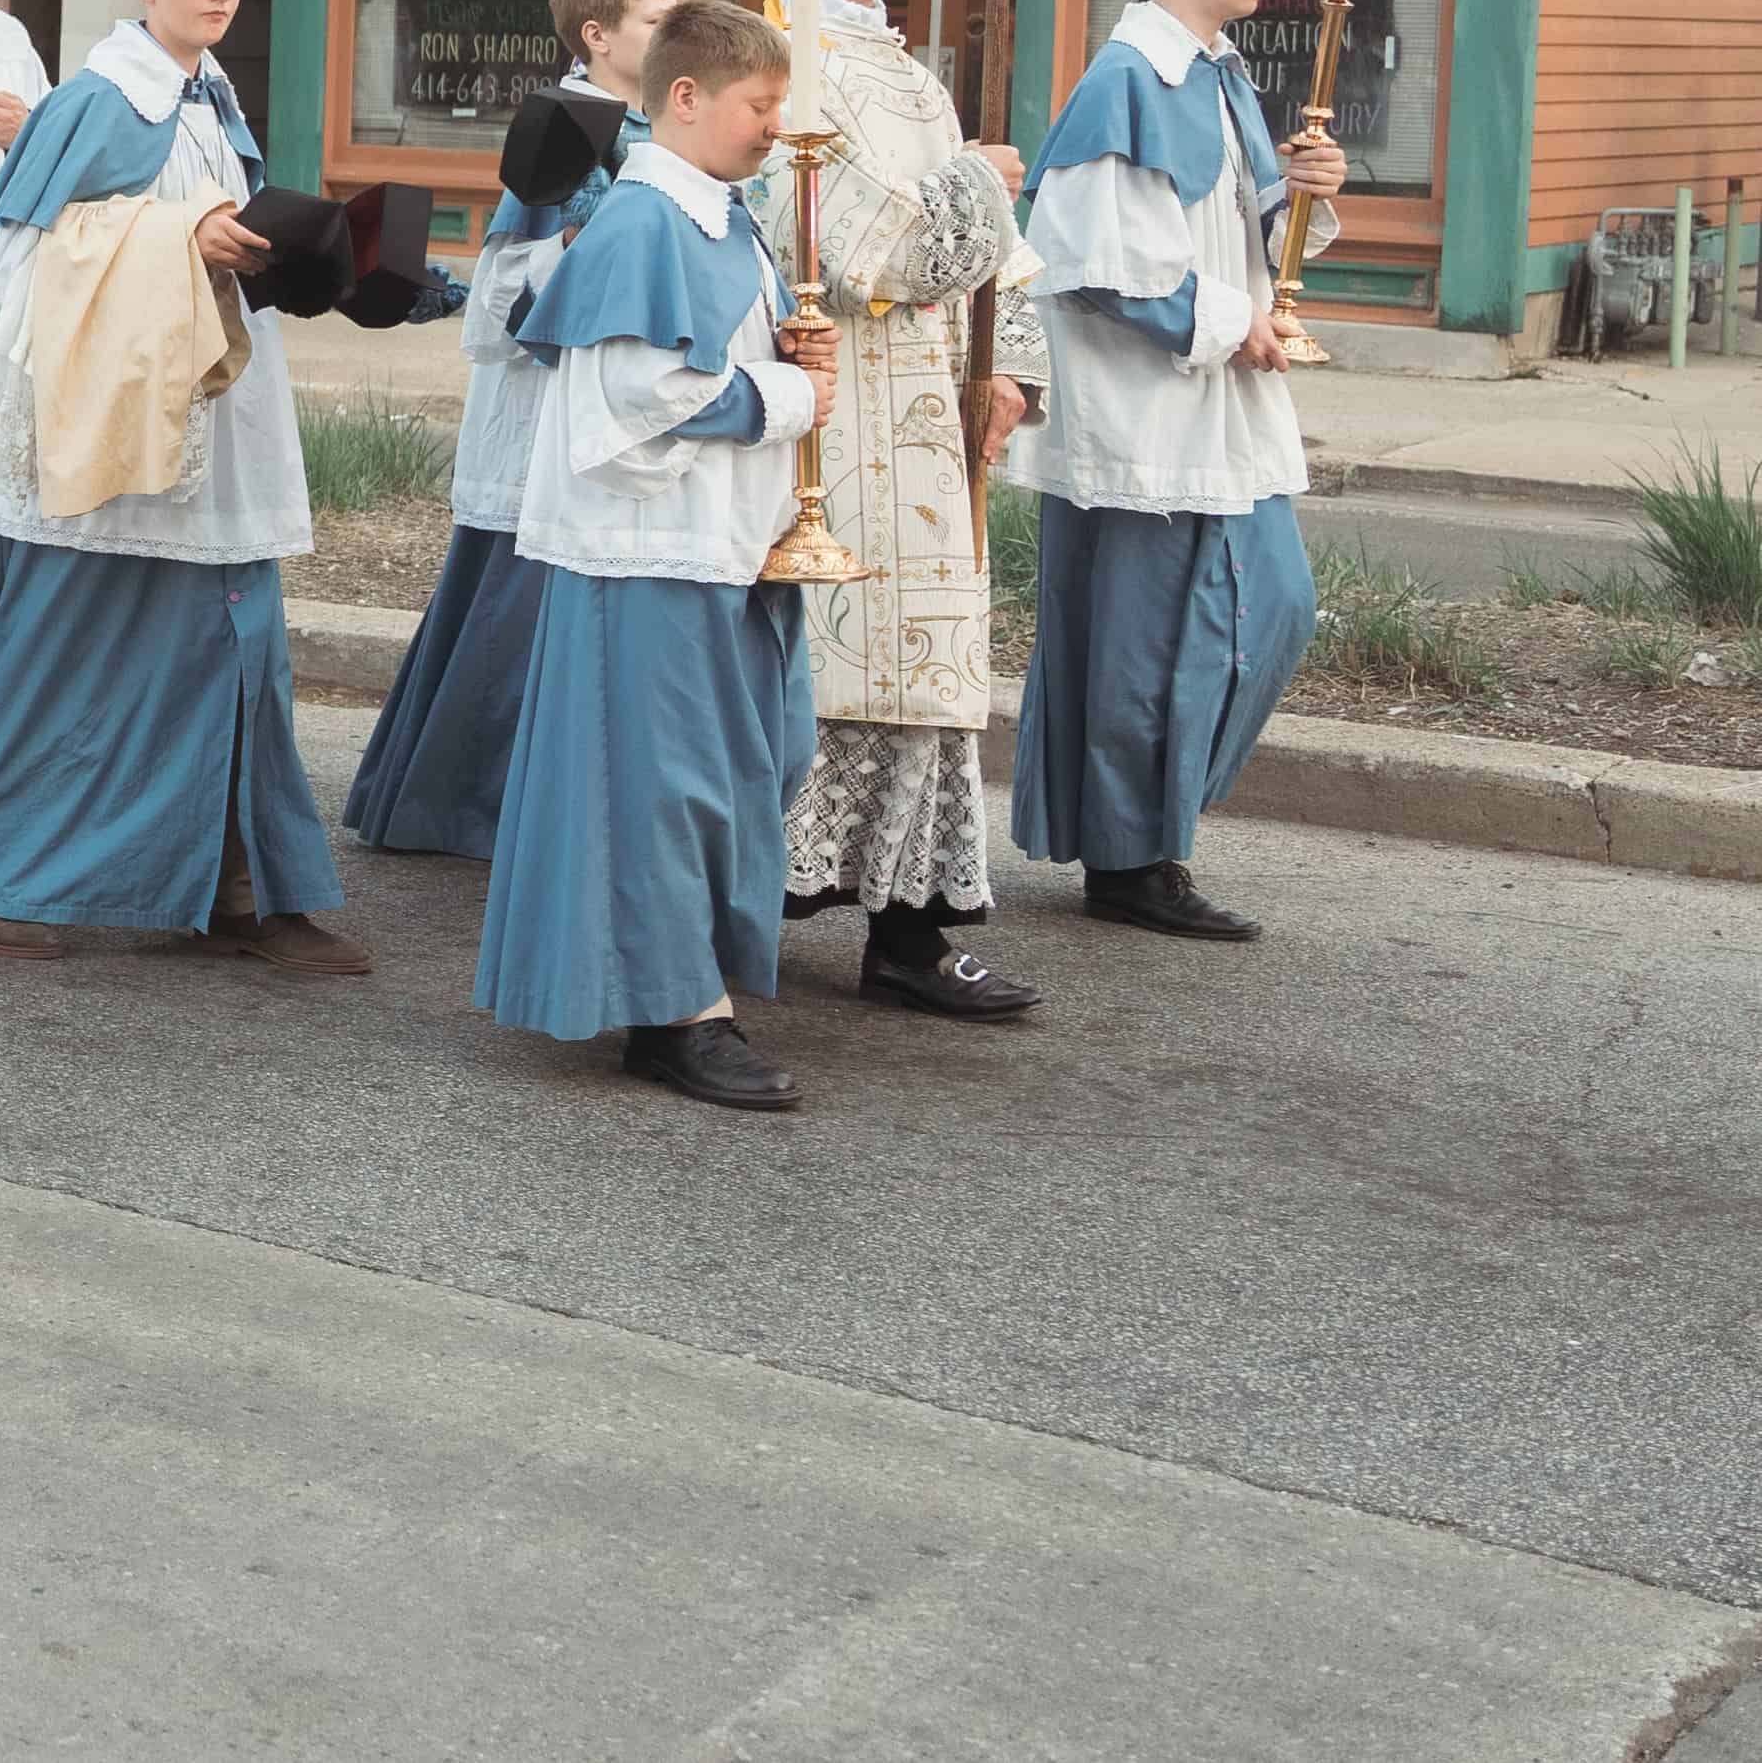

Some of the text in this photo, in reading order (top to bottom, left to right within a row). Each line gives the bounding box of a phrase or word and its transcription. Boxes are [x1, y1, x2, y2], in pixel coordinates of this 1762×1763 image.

[420, 32, 558, 64] RON SHAPIRO
[1285, 101, 1382, 135] INURY
